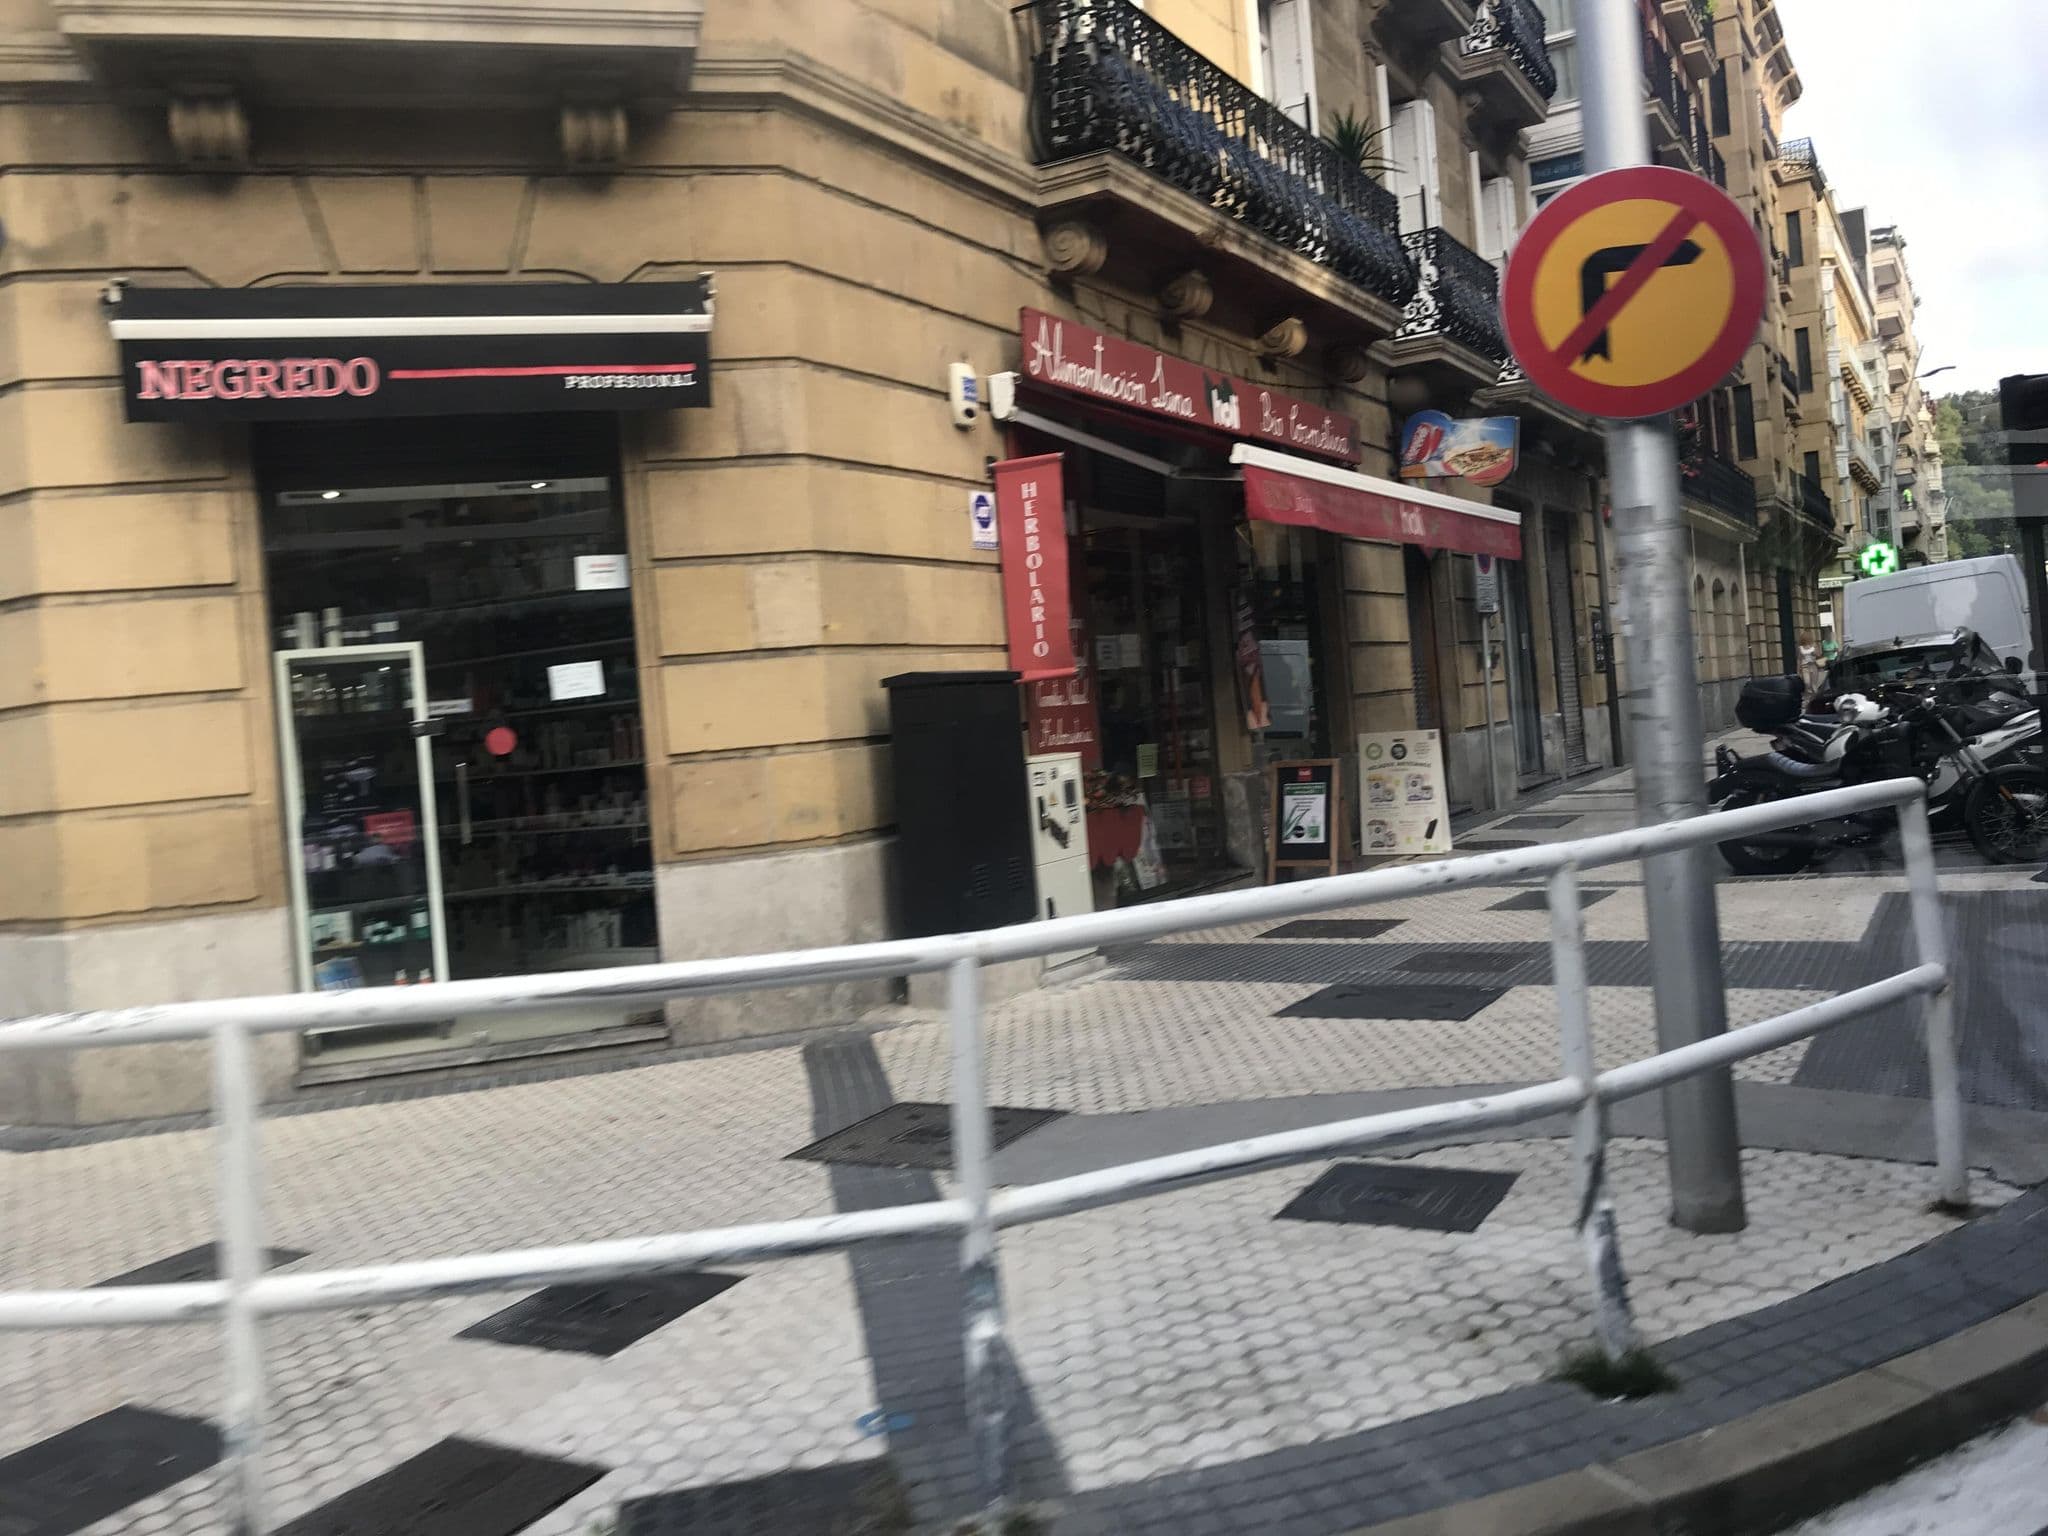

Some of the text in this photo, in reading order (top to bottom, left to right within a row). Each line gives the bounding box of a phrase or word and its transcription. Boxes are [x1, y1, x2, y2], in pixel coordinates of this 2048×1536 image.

[135, 356, 380, 400] NEGREDO
[564, 373, 697, 389] PROFESIONAL
[1259, 391, 1285, 436] Bio
[1020, 481, 1050, 658] HERBOLARIO
